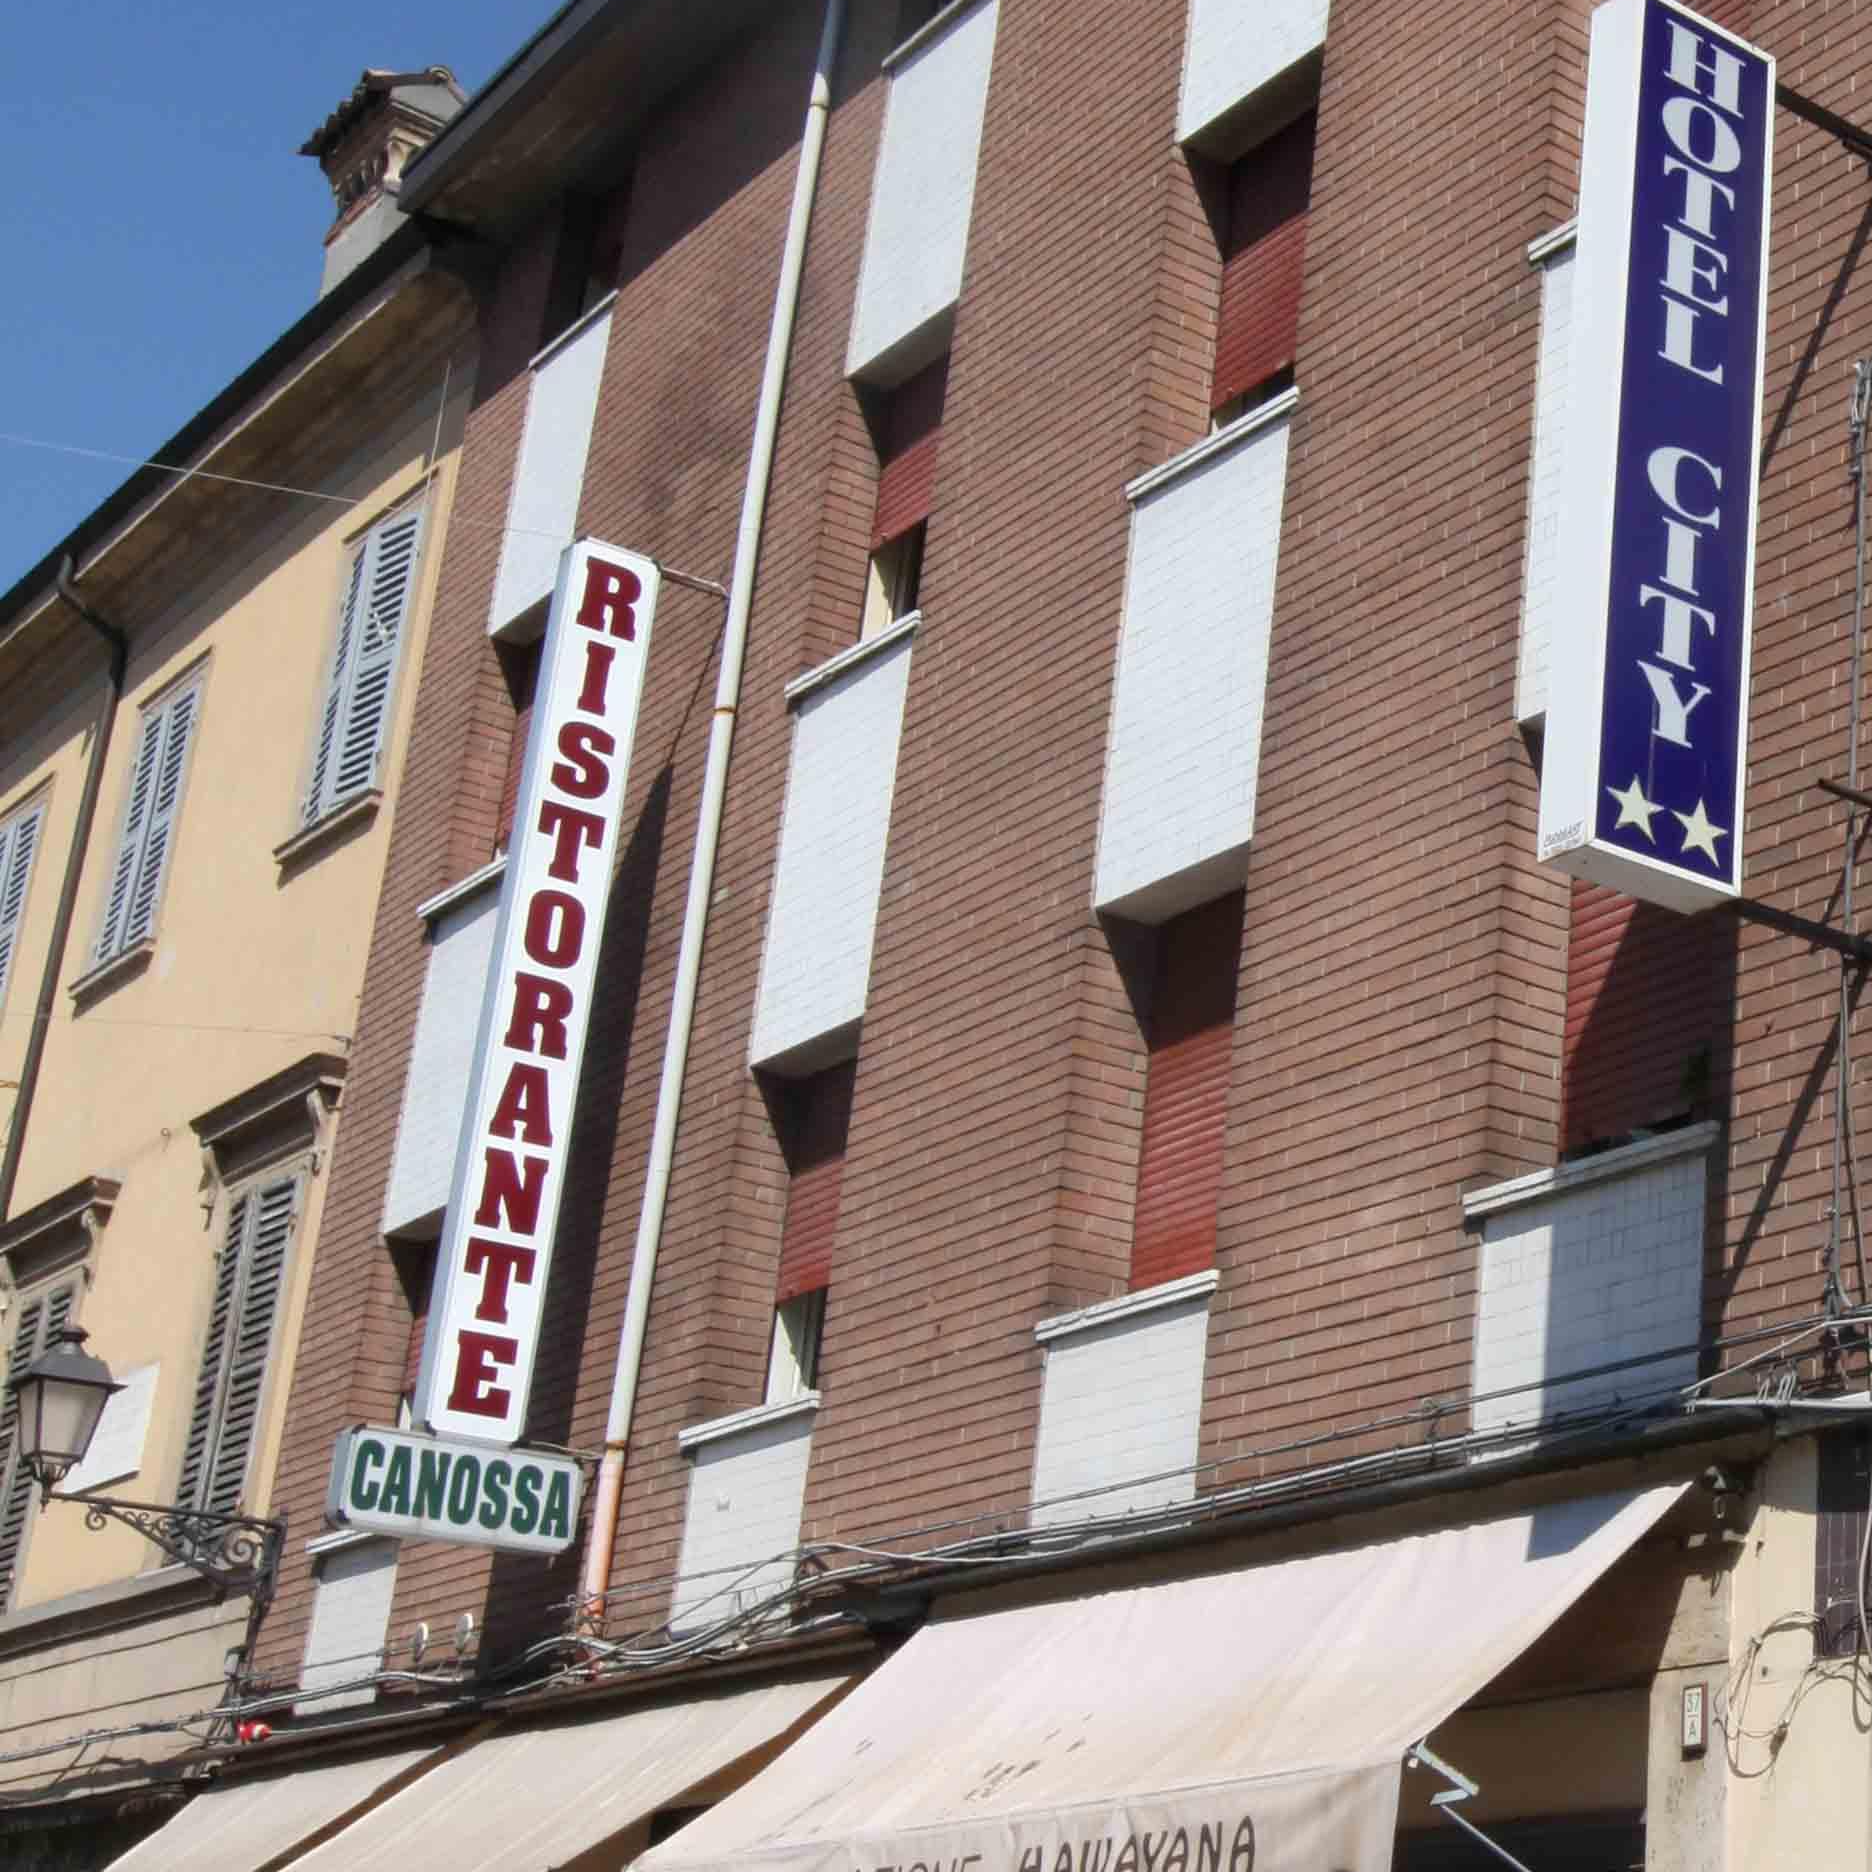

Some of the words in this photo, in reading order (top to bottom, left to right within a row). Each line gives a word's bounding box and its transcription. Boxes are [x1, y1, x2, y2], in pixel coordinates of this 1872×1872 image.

[1657, 18, 1747, 386] HOTEL
[1637, 446, 1723, 749] CITY
[449, 554, 641, 1418] RISTORANTE
[350, 1439, 571, 1539] CANOSSA
